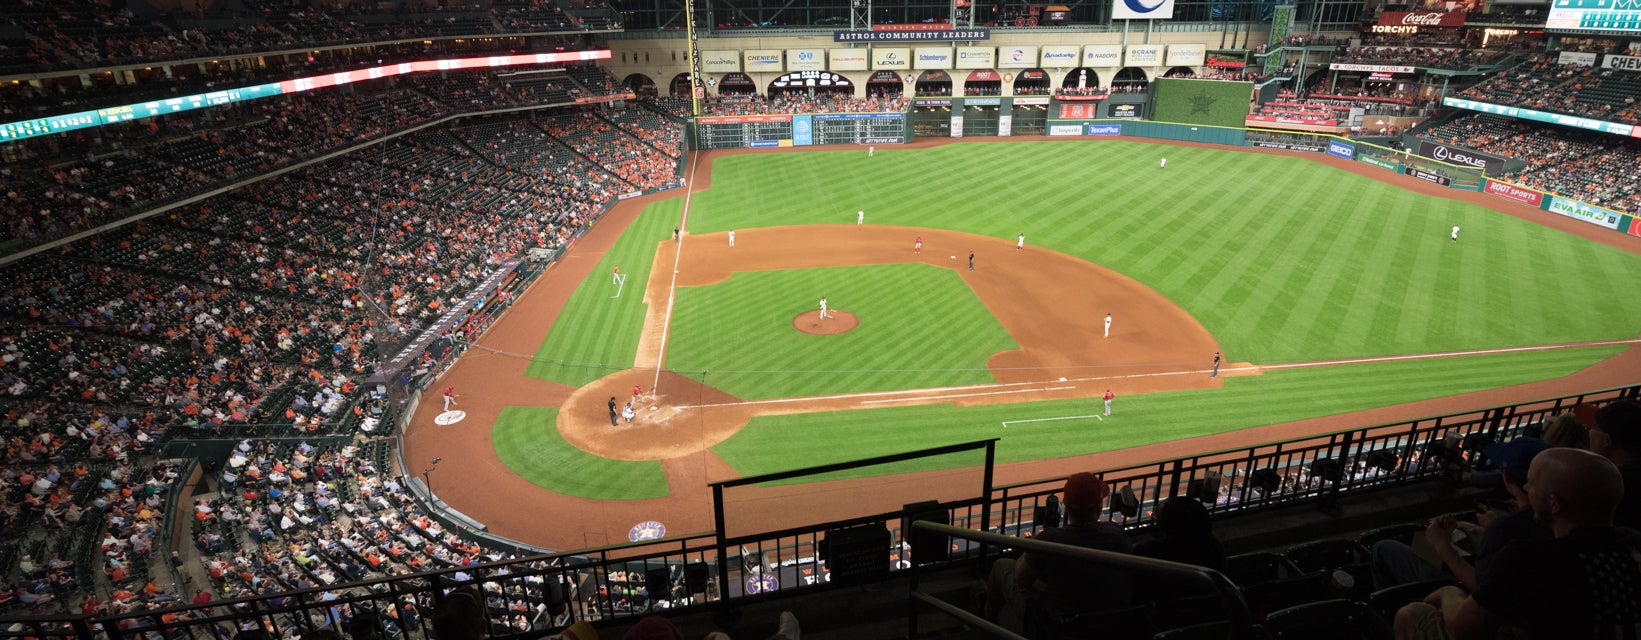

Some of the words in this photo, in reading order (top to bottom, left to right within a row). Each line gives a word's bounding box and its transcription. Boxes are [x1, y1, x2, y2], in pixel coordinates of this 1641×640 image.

[1372, 25, 1418, 33] TORCHYS
[1330, 144, 1351, 156] GEICO
[1448, 152, 1486, 168] LEXUS
[1490, 182, 1511, 193] ROOT
[1510, 188, 1537, 201] SPORTS
